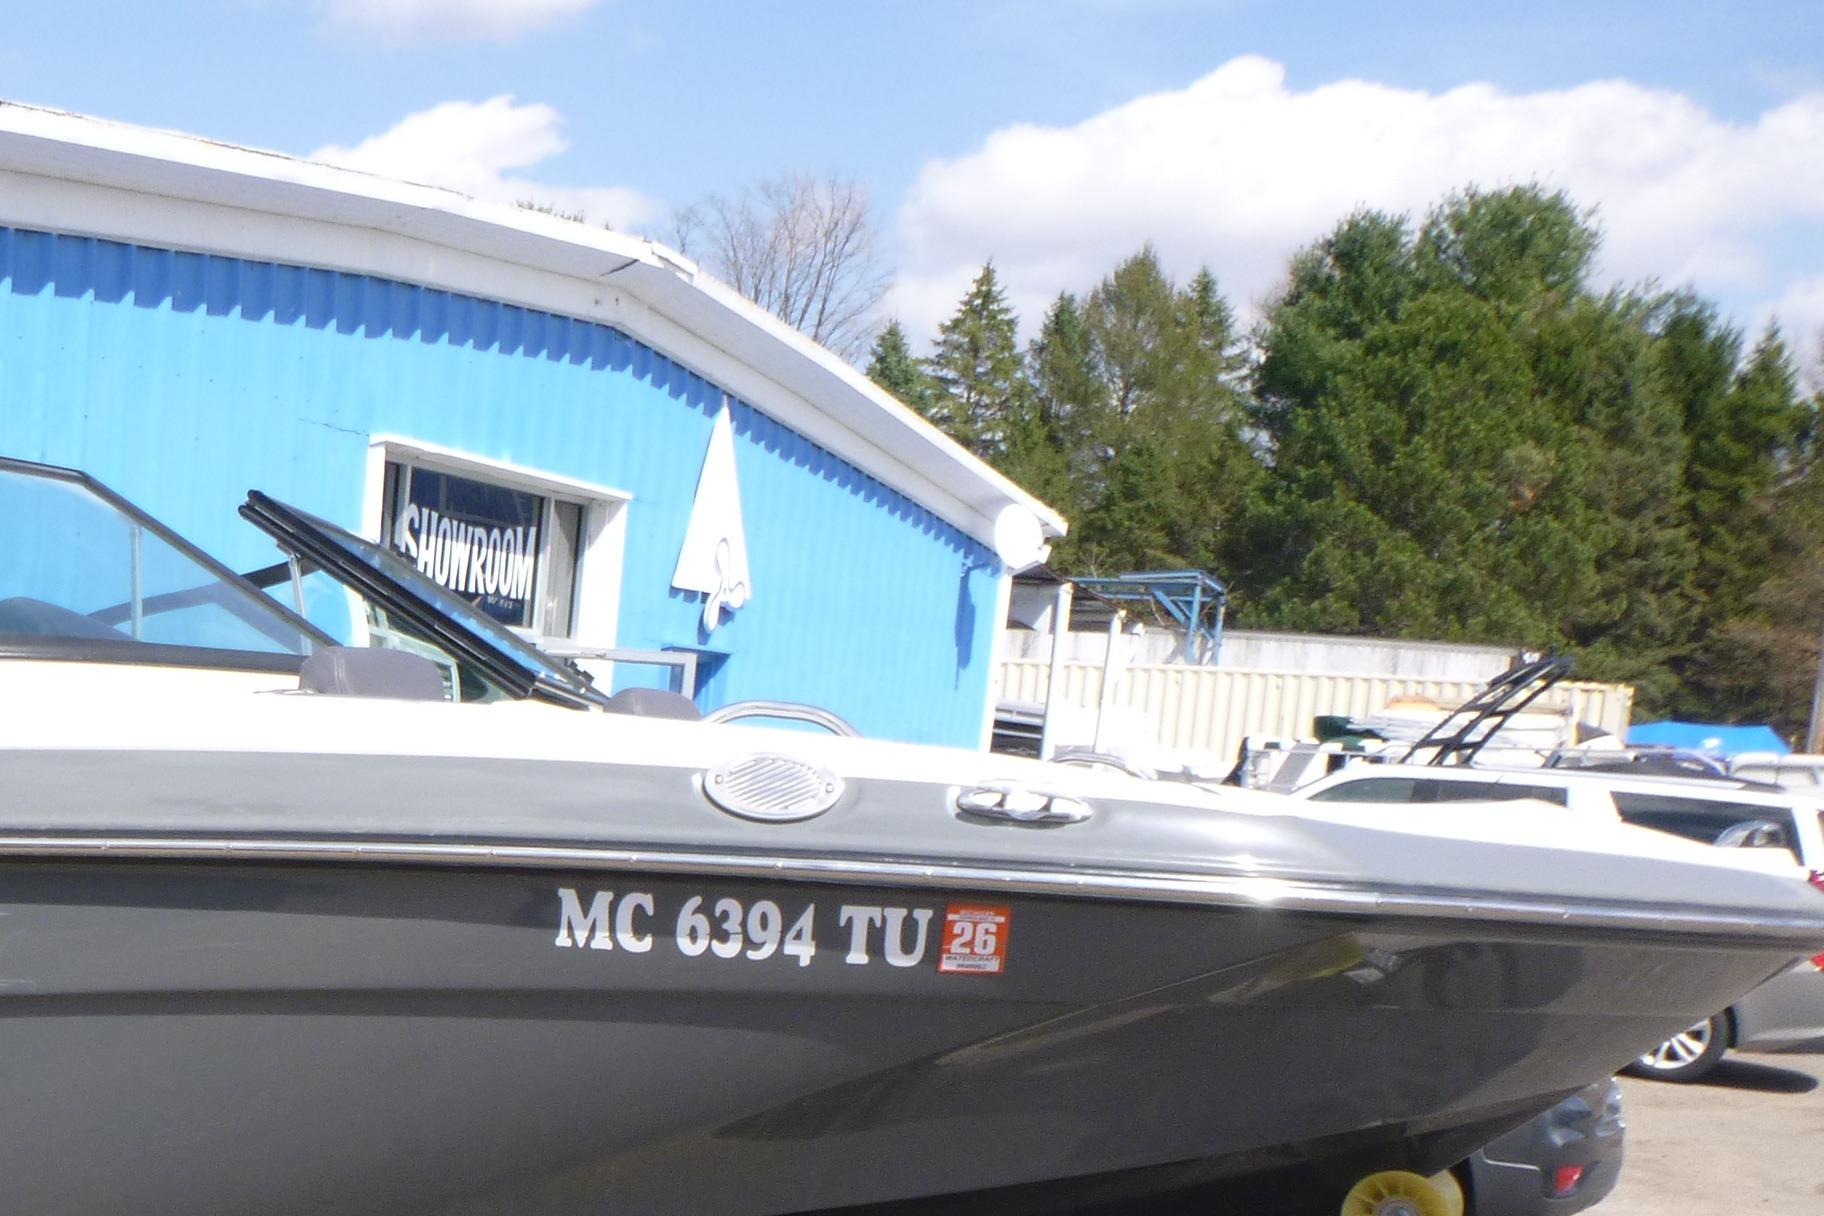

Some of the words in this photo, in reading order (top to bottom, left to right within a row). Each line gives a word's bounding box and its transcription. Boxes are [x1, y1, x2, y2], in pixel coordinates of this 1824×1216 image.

[396, 503, 537, 600] SHOWROOM
[555, 888, 654, 953] MC
[676, 896, 816, 967] 6394
[840, 905, 933, 968] TU
[950, 921, 997, 955] 26
